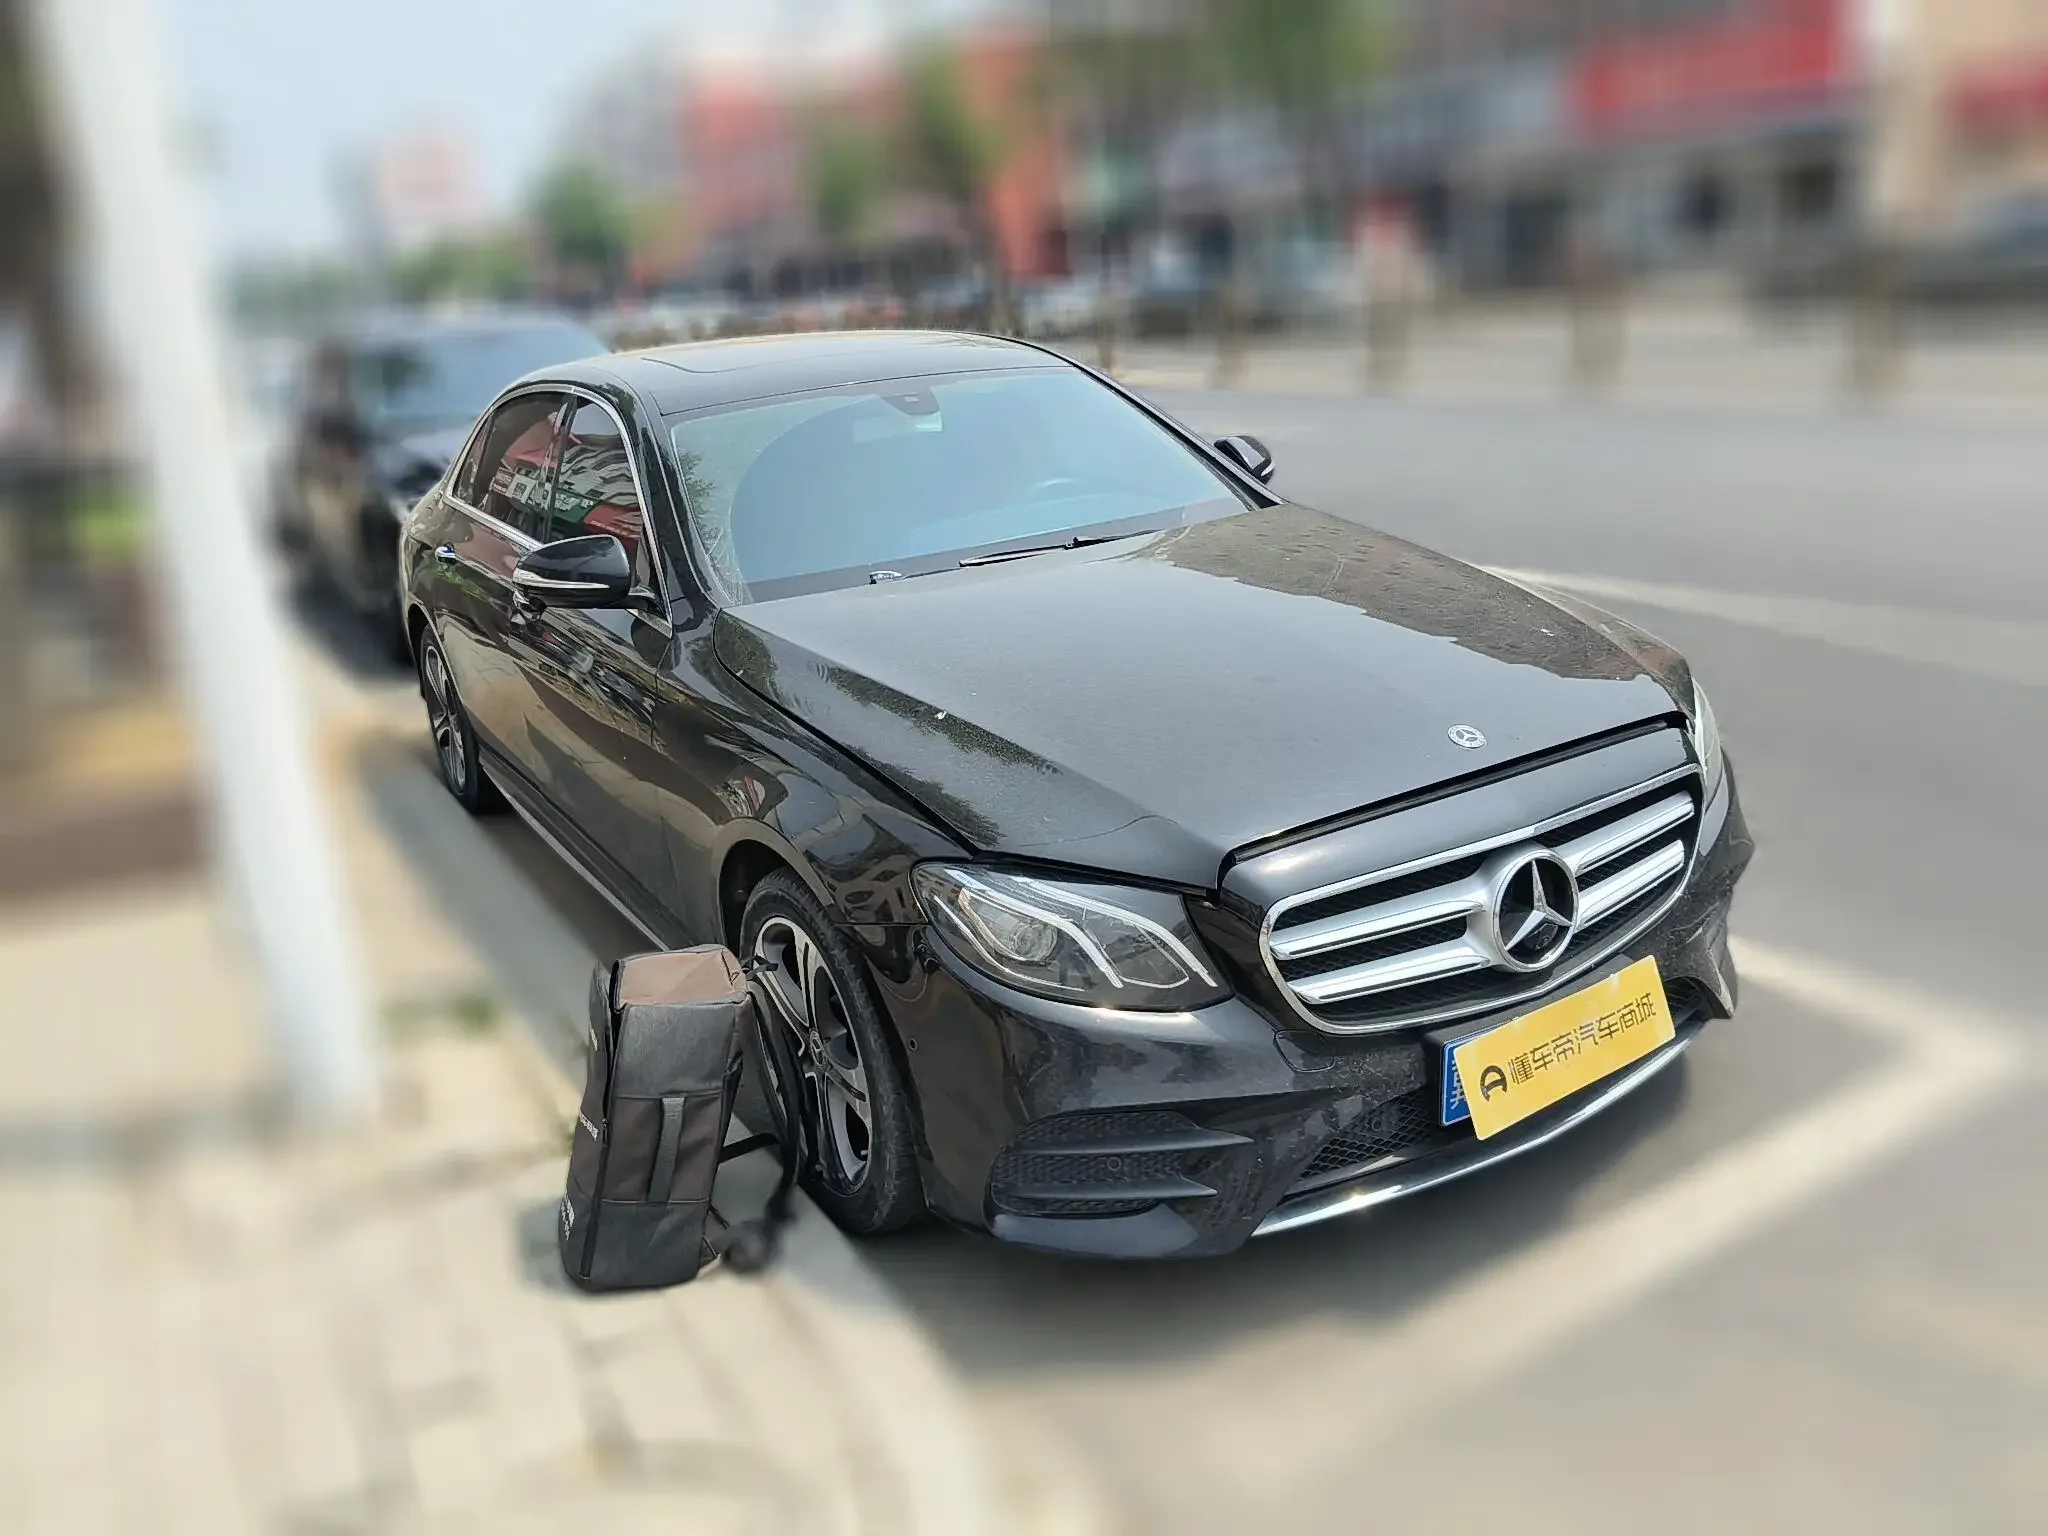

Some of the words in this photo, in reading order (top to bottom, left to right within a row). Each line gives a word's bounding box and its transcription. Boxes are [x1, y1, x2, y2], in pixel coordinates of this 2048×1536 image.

[1507, 991, 1657, 1085] 懂车帝汽车商城
